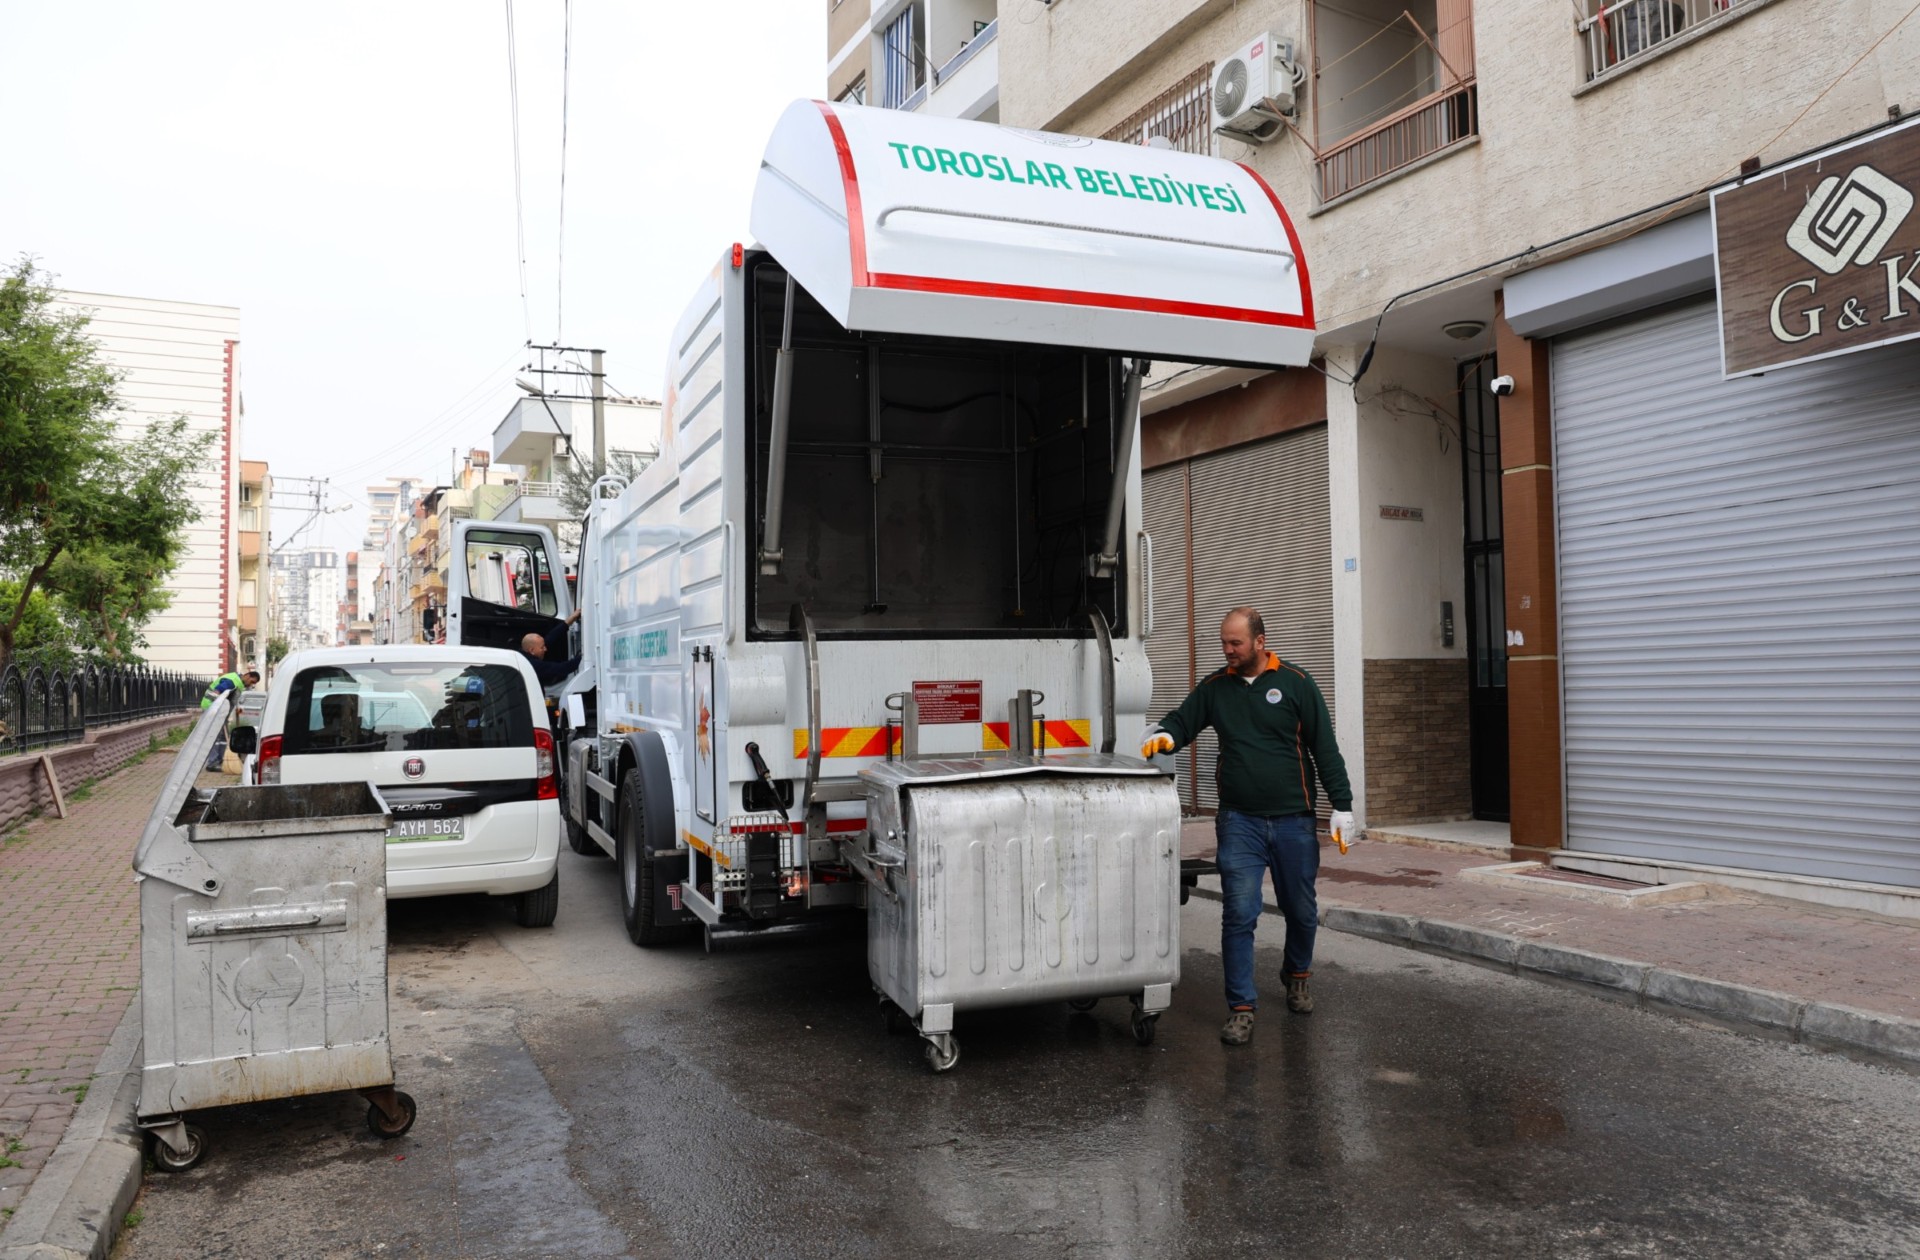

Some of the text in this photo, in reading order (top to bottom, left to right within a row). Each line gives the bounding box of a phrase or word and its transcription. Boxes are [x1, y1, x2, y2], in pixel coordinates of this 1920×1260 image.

[888, 142, 1247, 214] TOROSLAR BELEDİYESİ
[1770, 278, 1825, 343] G
[1837, 297, 1869, 331] &
[408, 763, 421, 773] FIAT
[399, 821, 426, 836] AYM
[434, 819, 460, 834] 562
